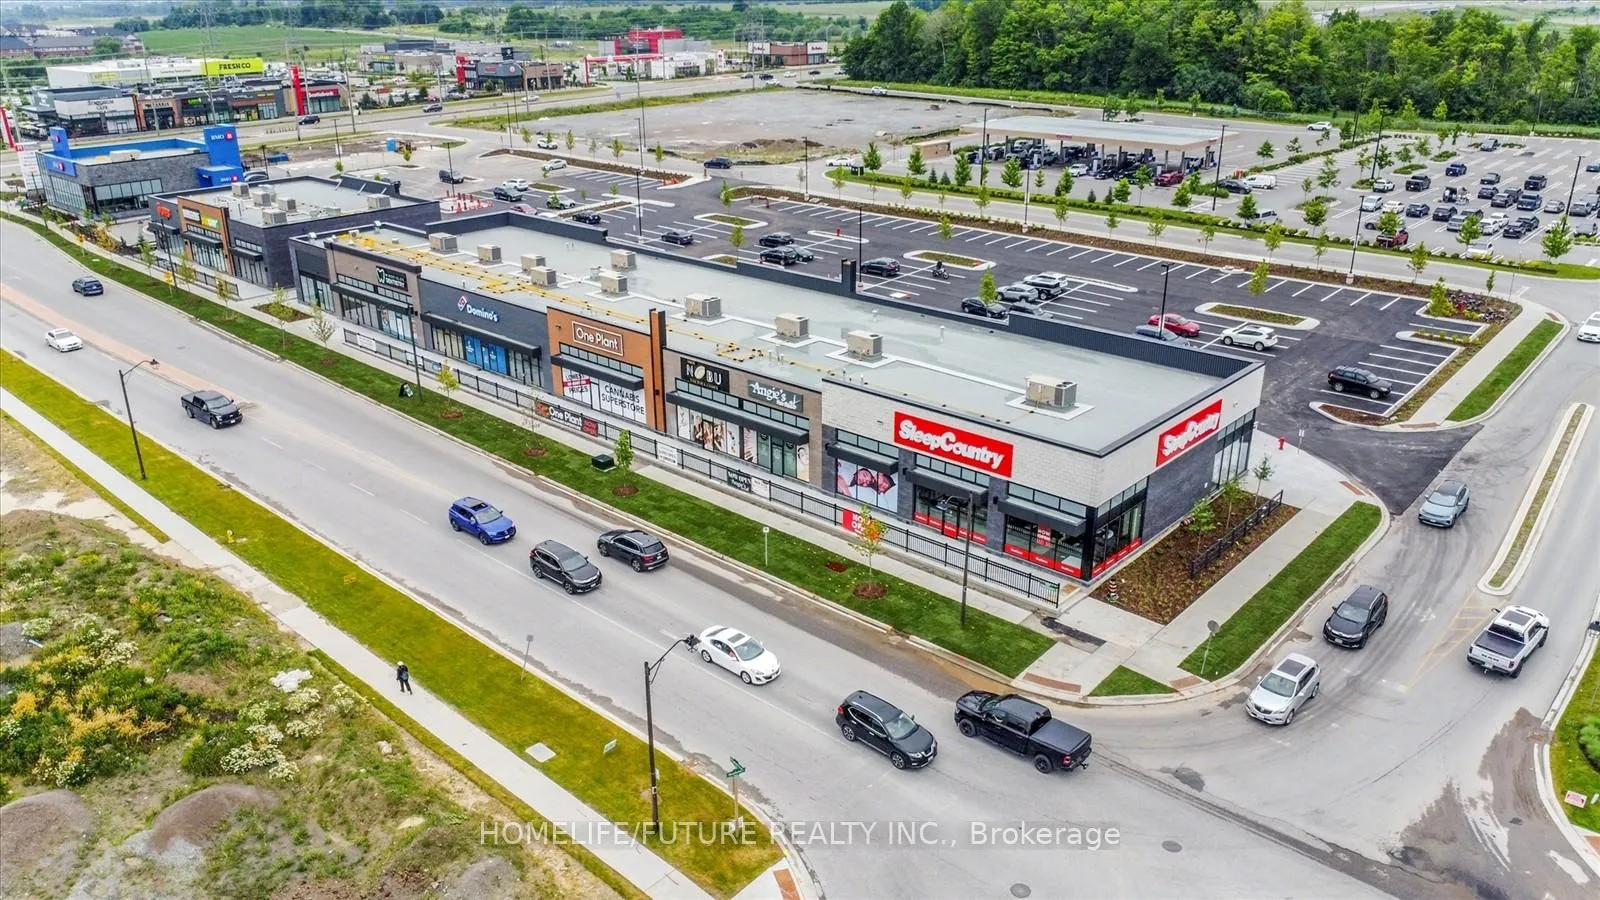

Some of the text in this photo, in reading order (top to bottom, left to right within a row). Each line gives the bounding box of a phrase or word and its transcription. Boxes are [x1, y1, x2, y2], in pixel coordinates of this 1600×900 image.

[466, 304, 498, 322] Domino's
[576, 328, 618, 349] One Plant
[604, 385, 640, 404] CANNABIS
[749, 382, 786, 402] Angie's
[602, 393, 645, 415] SUPERSTORE
[549, 406, 564, 420] One
[564, 411, 583, 427] Plant
[899, 419, 1004, 469] SleepCountry
